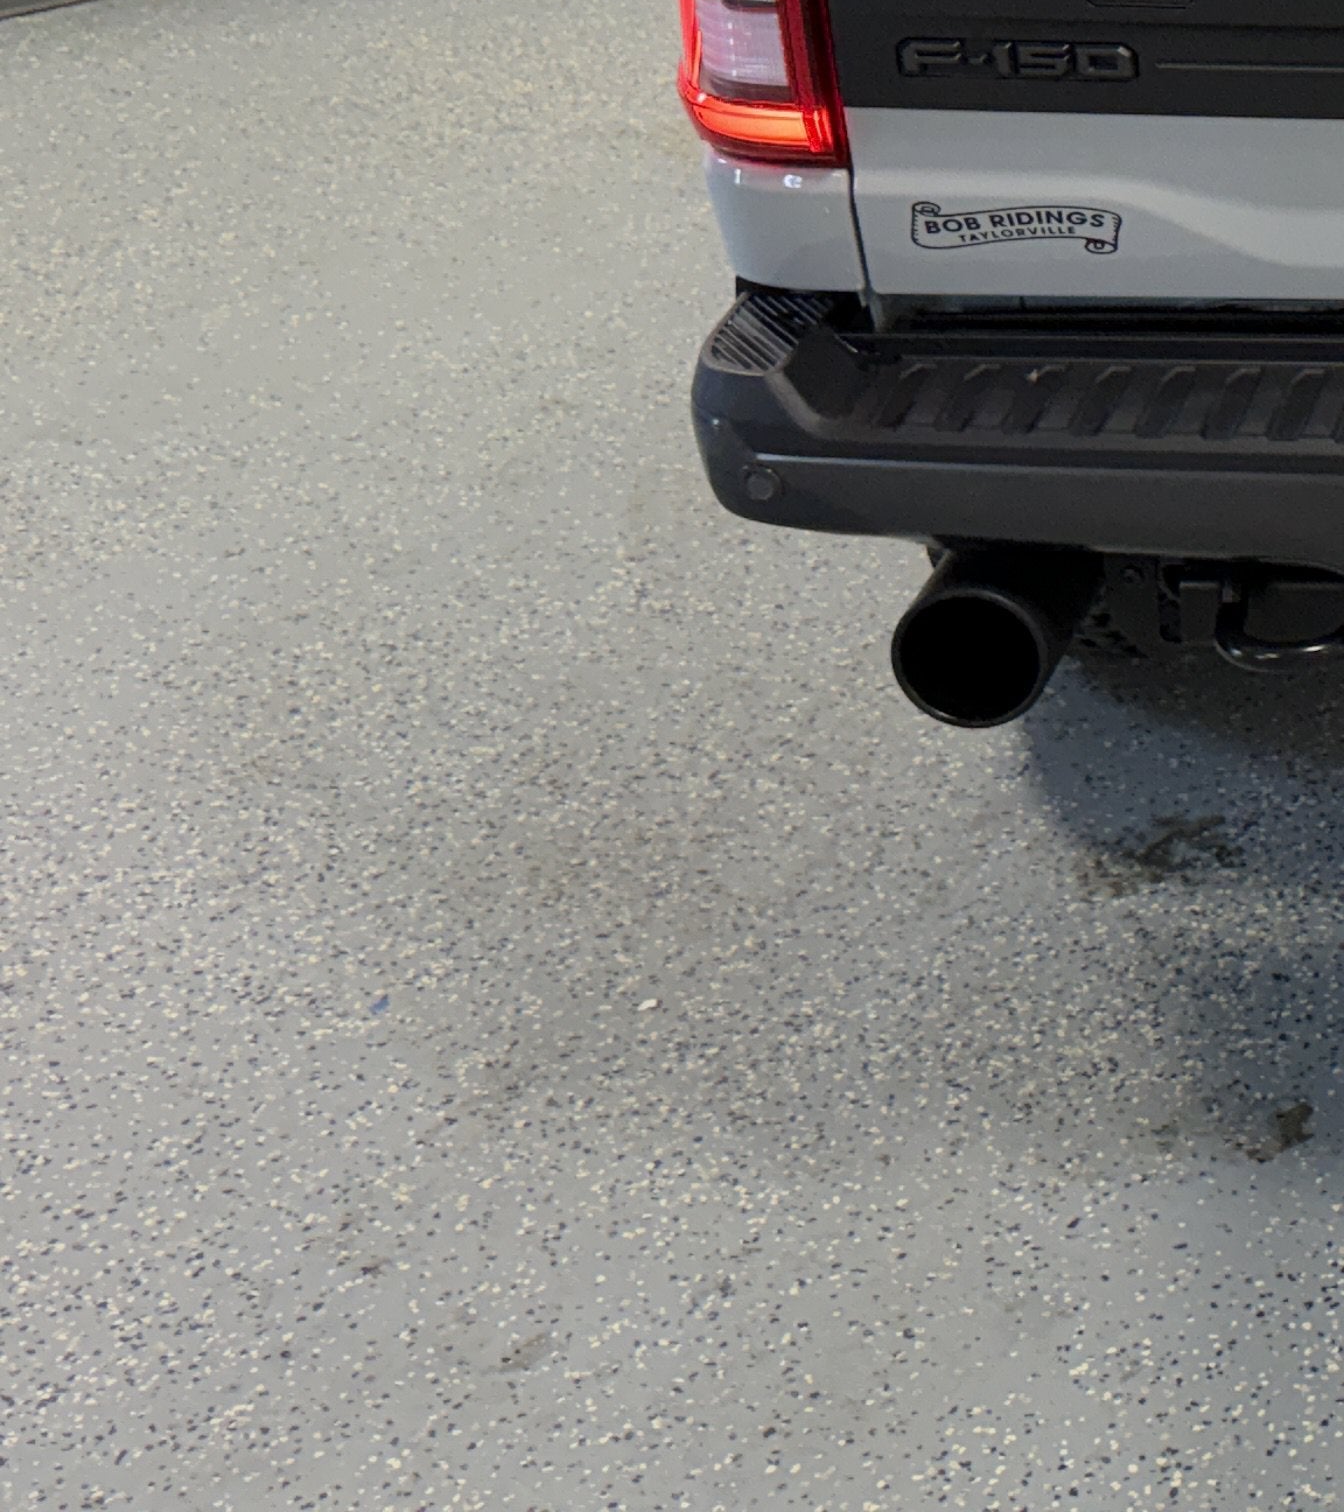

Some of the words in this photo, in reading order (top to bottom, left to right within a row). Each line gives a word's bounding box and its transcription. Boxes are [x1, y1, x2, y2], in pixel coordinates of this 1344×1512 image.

[897, 38, 1138, 81] F-150
[924, 216, 981, 235] BOB
[989, 210, 1105, 229] RIDINGS
[959, 226, 1076, 243] TAYLORVILLE
